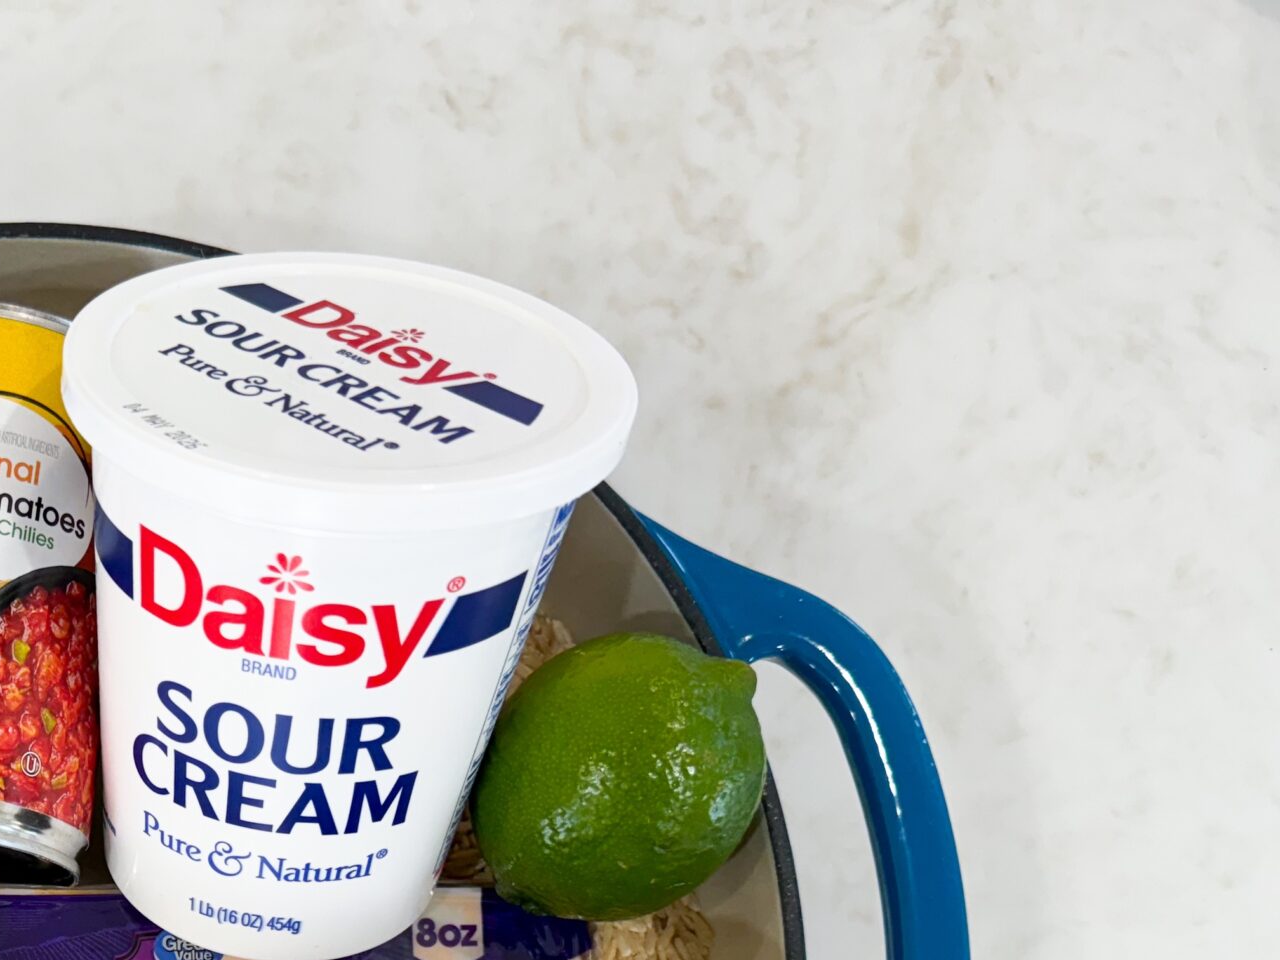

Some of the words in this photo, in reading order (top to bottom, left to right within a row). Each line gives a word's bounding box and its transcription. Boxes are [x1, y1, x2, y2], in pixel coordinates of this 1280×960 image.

[158, 343, 228, 381] Pure
[225, 375, 281, 399] &
[174, 308, 306, 368] SOUR
[297, 364, 474, 444] CREAM
[337, 348, 370, 365] BRAND
[241, 658, 297, 682] BRAND
[156, 680, 401, 776] SOUR
[132, 733, 418, 836] CREAM
[142, 810, 201, 862] Pure
[207, 840, 252, 877] &
[162, 934, 203, 951] Gre
[188, 897, 196, 911] 1
[198, 899, 214, 918] Lb
[217, 905, 238, 926] (16
[241, 911, 264, 932] OZ)
[267, 913, 302, 935] 454g
